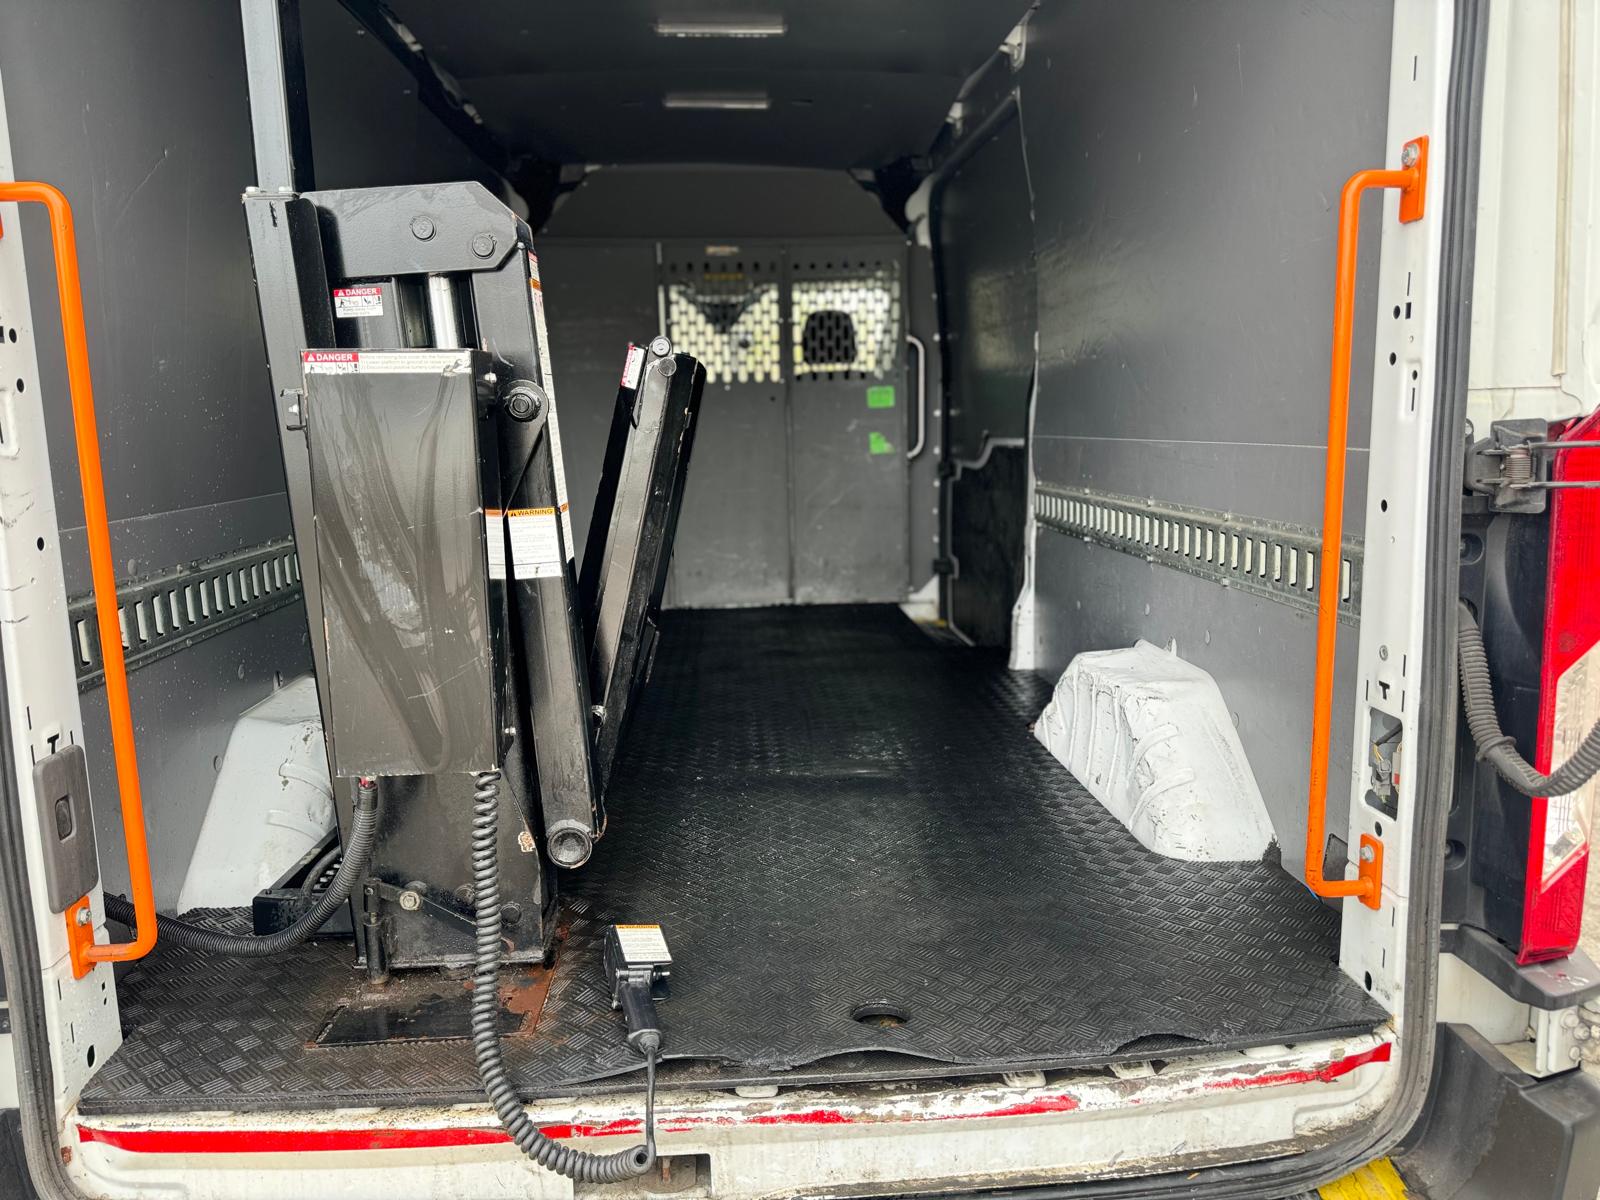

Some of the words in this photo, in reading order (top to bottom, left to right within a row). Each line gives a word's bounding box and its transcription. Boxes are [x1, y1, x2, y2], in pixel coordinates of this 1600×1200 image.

[345, 287, 377, 296] DANGER
[316, 353, 353, 362] DANGER
[517, 508, 553, 516] WARNING
